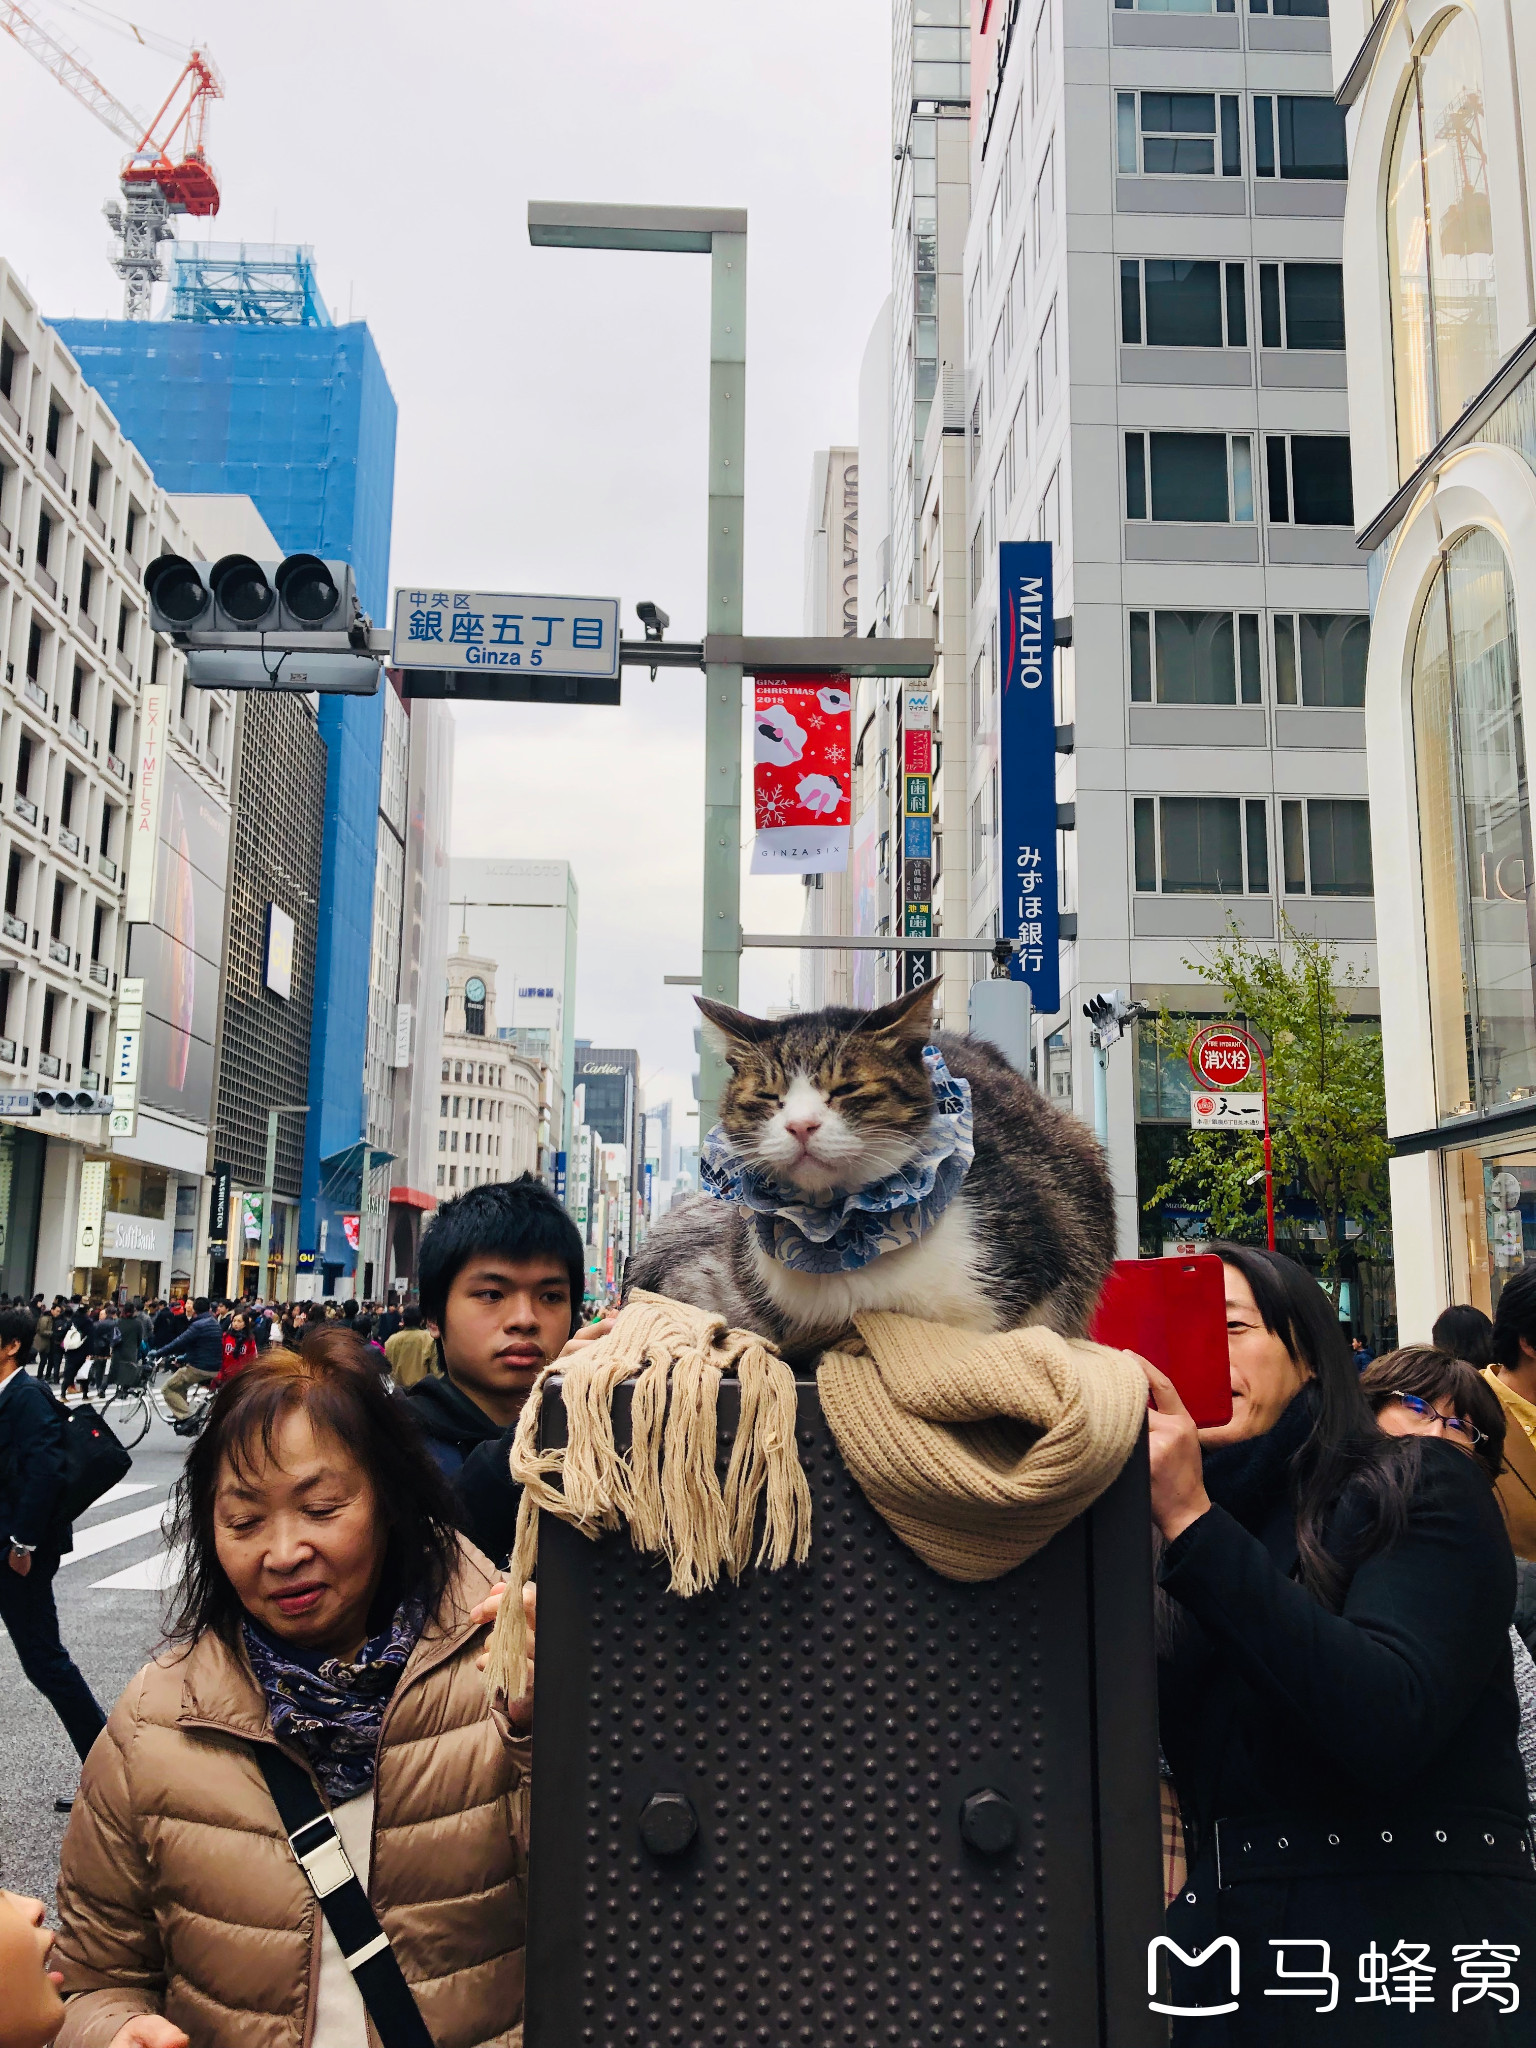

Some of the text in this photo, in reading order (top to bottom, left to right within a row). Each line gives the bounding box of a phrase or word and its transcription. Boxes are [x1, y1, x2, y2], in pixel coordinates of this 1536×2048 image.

[410, 591, 471, 610] 中央区
[407, 610, 603, 649] 銀座五丁目
[1019, 577, 1042, 688] MIZUHO
[466, 646, 543, 666] Ginza 5
[756, 687, 815, 696] CHRISTMAS
[756, 696, 785, 704] 2018
[910, 779, 926, 812] 歯科
[761, 846, 840, 857] GINZA SIX
[1017, 845, 1043, 972] みずほ銀行
[121, 1036, 132, 1077] PLAZA
[1205, 1050, 1246, 1069] 消火栓
[583, 1061, 624, 1075] Cartier
[216, 1175, 226, 1228] WASHINGTON
[366, 1193, 386, 1216] ASAKI
[115, 1222, 156, 1251] SoftBank
[299, 1253, 315, 1263] GU
